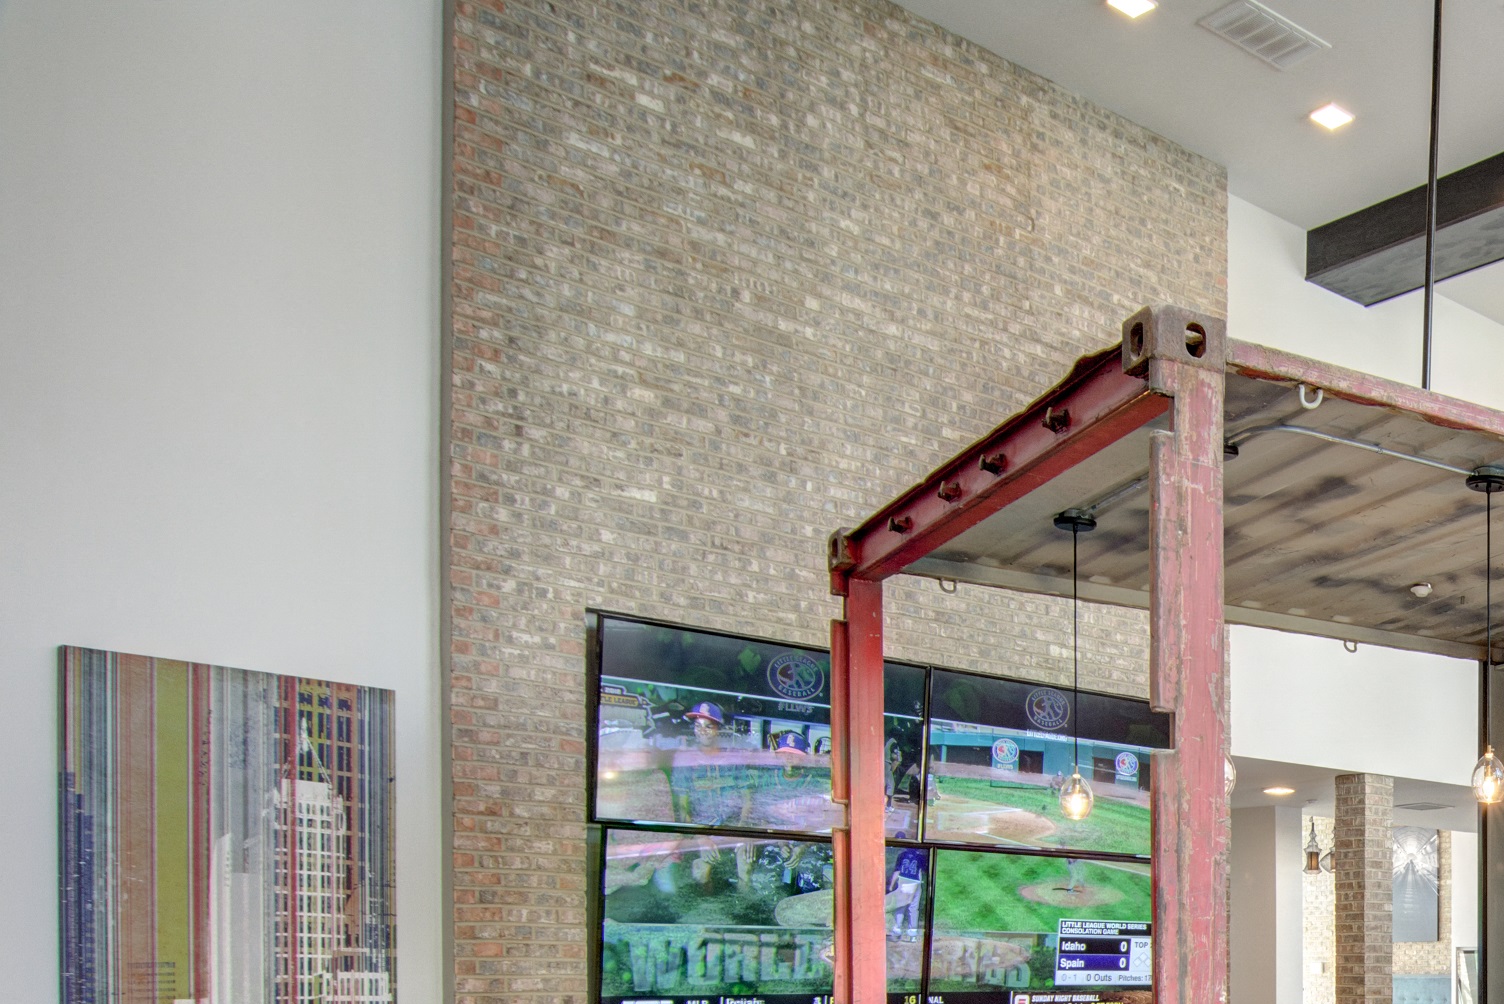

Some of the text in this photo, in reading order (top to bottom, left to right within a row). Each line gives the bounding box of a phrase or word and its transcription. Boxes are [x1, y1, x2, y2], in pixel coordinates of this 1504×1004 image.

[1061, 941, 1148, 952] Idaho 0 TOP
[1060, 957, 1126, 969] Spain 0
[1094, 973, 1112, 981] Outs
[904, 995, 917, 1004] 16
[1072, 994, 1100, 1002] BASEBALL
